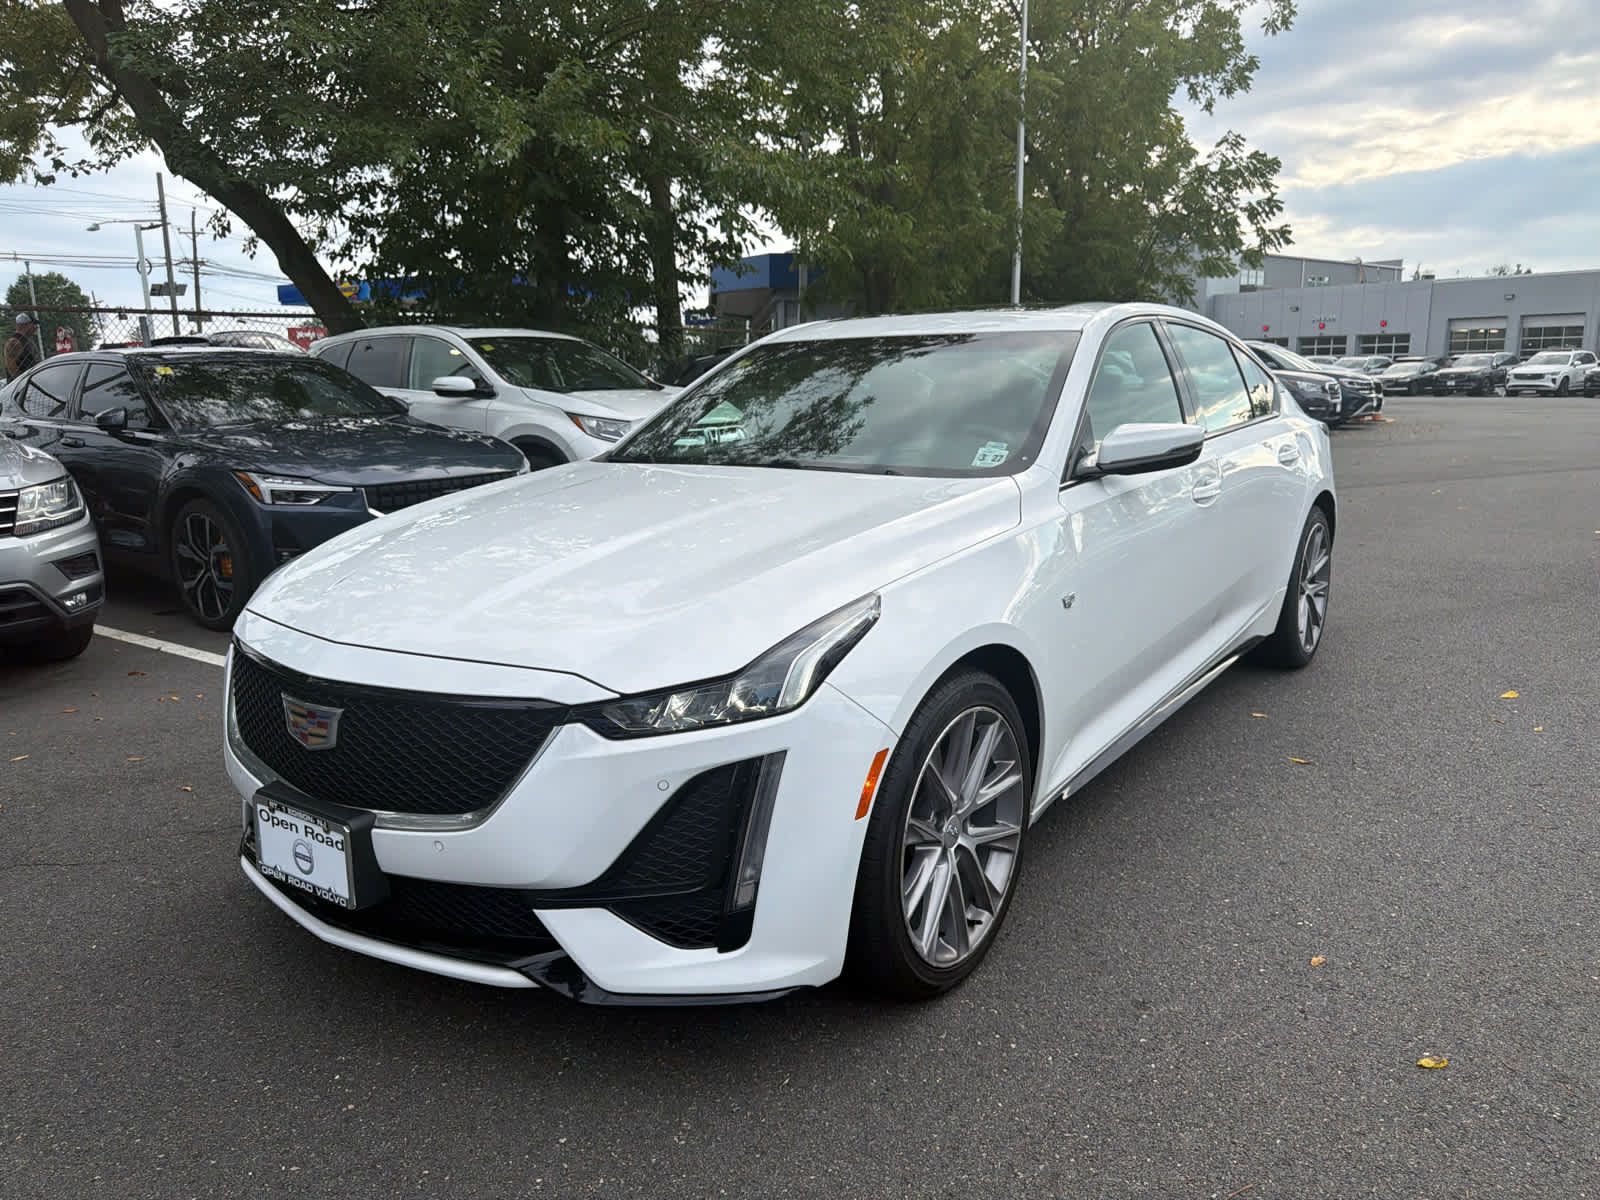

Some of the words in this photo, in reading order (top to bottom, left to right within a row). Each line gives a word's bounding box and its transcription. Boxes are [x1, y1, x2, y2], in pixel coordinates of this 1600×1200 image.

[991, 454, 1004, 462] 27
[259, 808, 299, 834] Open
[304, 826, 345, 852] Road
[262, 866, 286, 882] OPEN
[288, 877, 313, 893] ROAD
[316, 887, 347, 907] VOLVO
